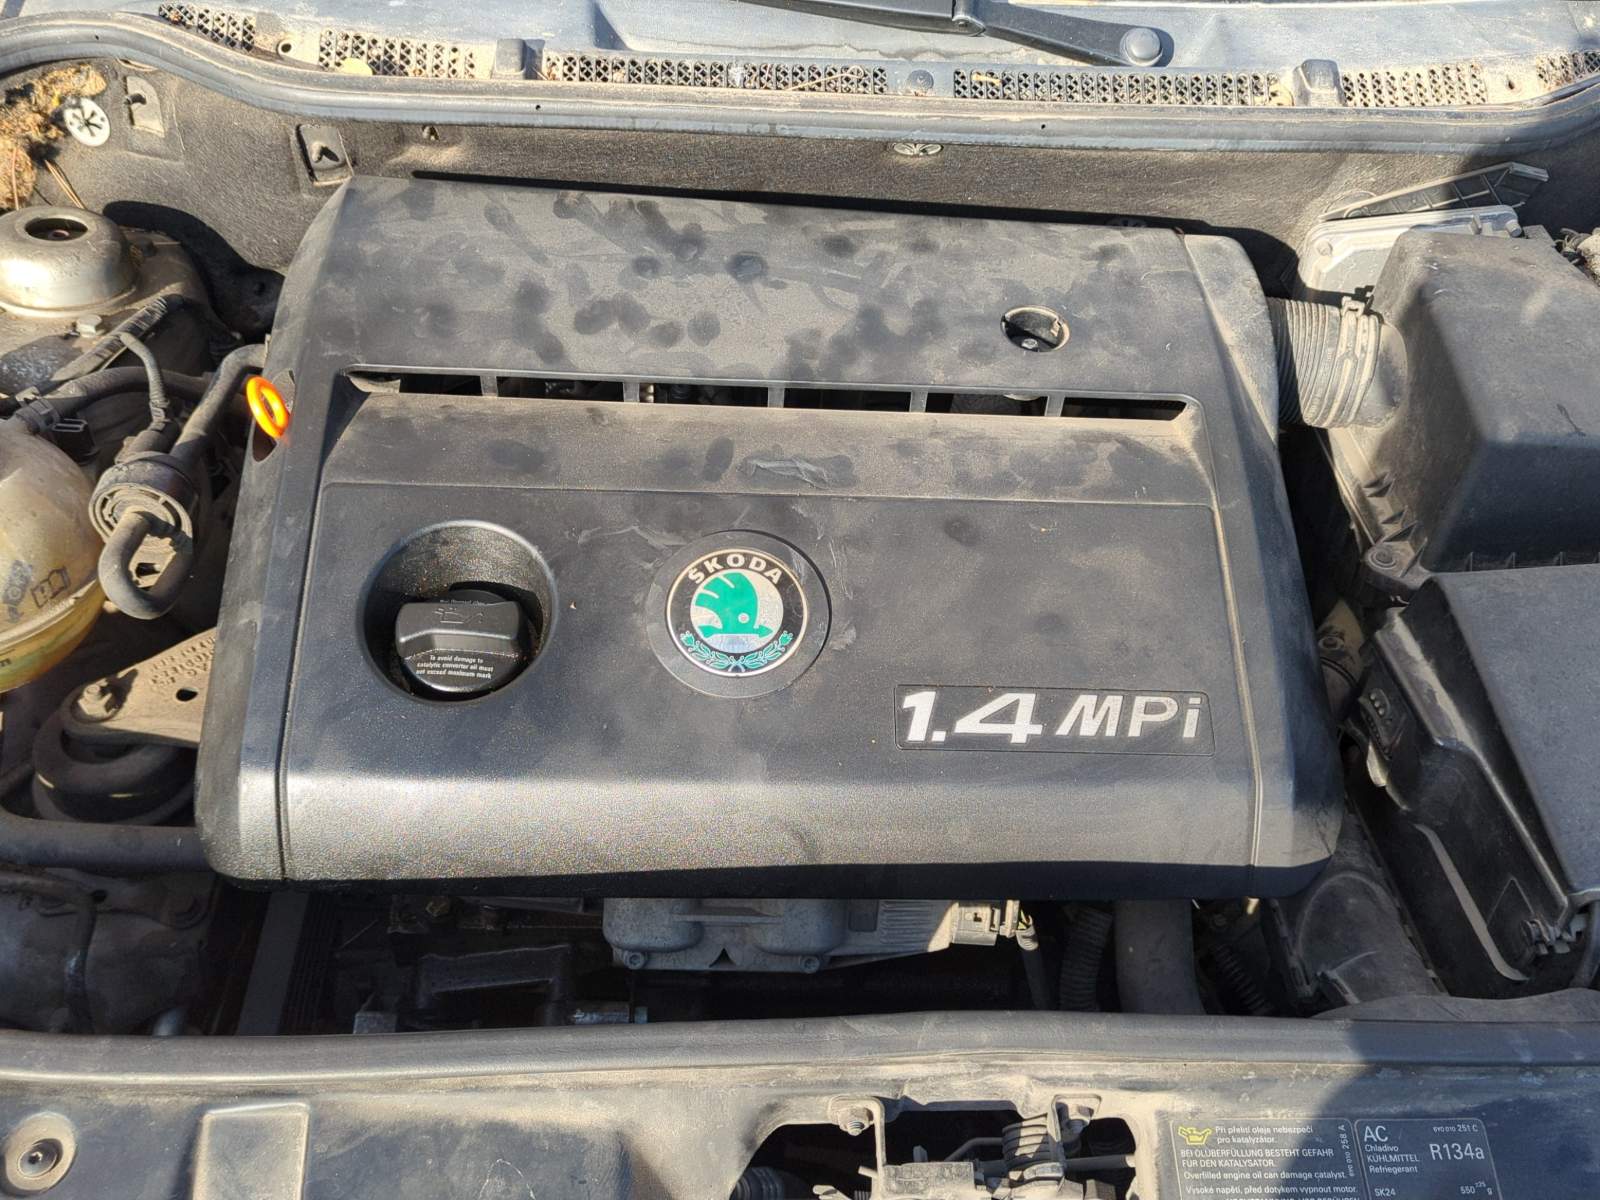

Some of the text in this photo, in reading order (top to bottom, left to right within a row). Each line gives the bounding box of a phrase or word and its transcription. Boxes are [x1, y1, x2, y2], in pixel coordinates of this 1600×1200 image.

[902, 691, 1202, 744] 1.4 MPi
[1472, 1124, 1478, 1132] C
[1363, 1125, 1388, 1142] AC
[1180, 1149, 1193, 1157] BEI
[1265, 1148, 1300, 1157] BESTEHT
[1302, 1148, 1334, 1157] GEFAHR
[1365, 1144, 1399, 1152] Chladivo
[1429, 1142, 1485, 1160] R134a
[1200, 1159, 1217, 1168] DEN
[1369, 1165, 1418, 1175] Refriegerant
[1183, 1171, 1221, 1179] Overfilled
[1223, 1171, 1251, 1181] engine
[1252, 1171, 1262, 1179] oil
[1280, 1171, 1313, 1180] damage
[1264, 1185, 1298, 1195] dotykem
[1300, 1186, 1331, 1194] vypnout
[1374, 1188, 1396, 1196] SK24
[1460, 1185, 1476, 1194] 550
[1487, 1187, 1493, 1195] g
